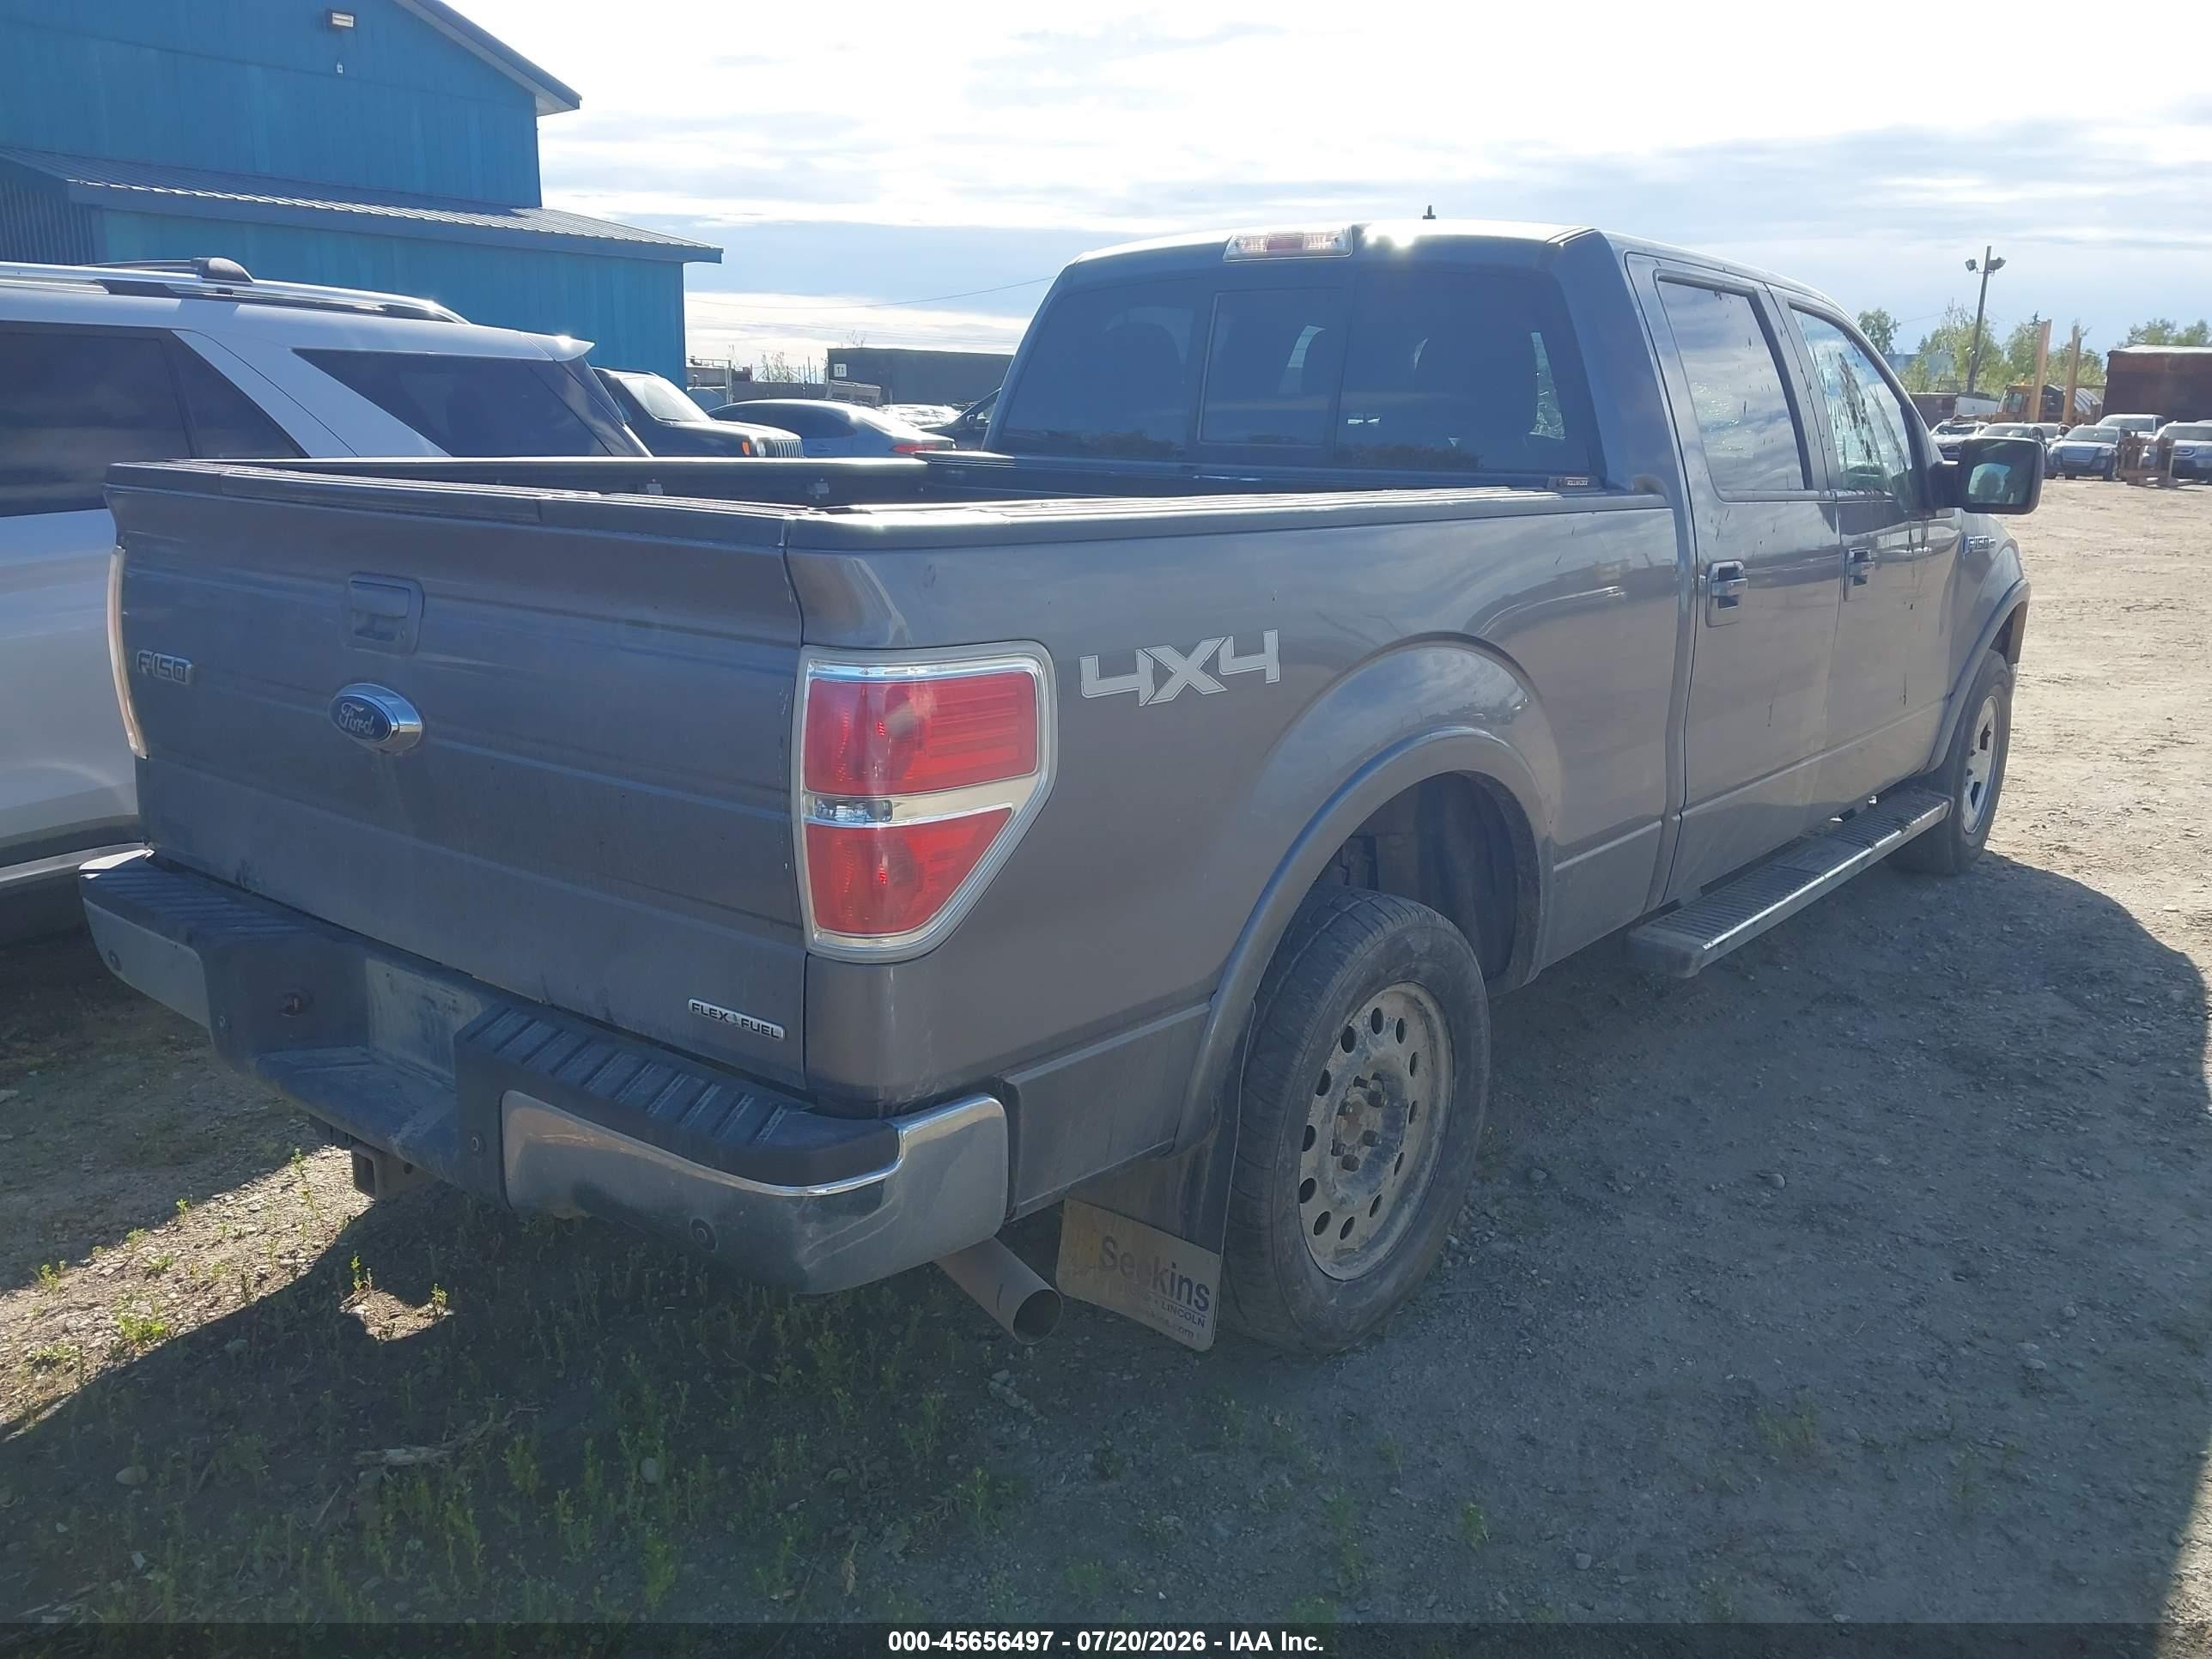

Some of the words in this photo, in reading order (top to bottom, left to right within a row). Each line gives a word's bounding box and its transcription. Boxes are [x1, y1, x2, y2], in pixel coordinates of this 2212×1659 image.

[338, 702, 375, 736] Ford
[691, 1002, 729, 1024] FLEX
[740, 1018, 781, 1039] FUEL
[1161, 1300, 1205, 1328] LINCOLN
